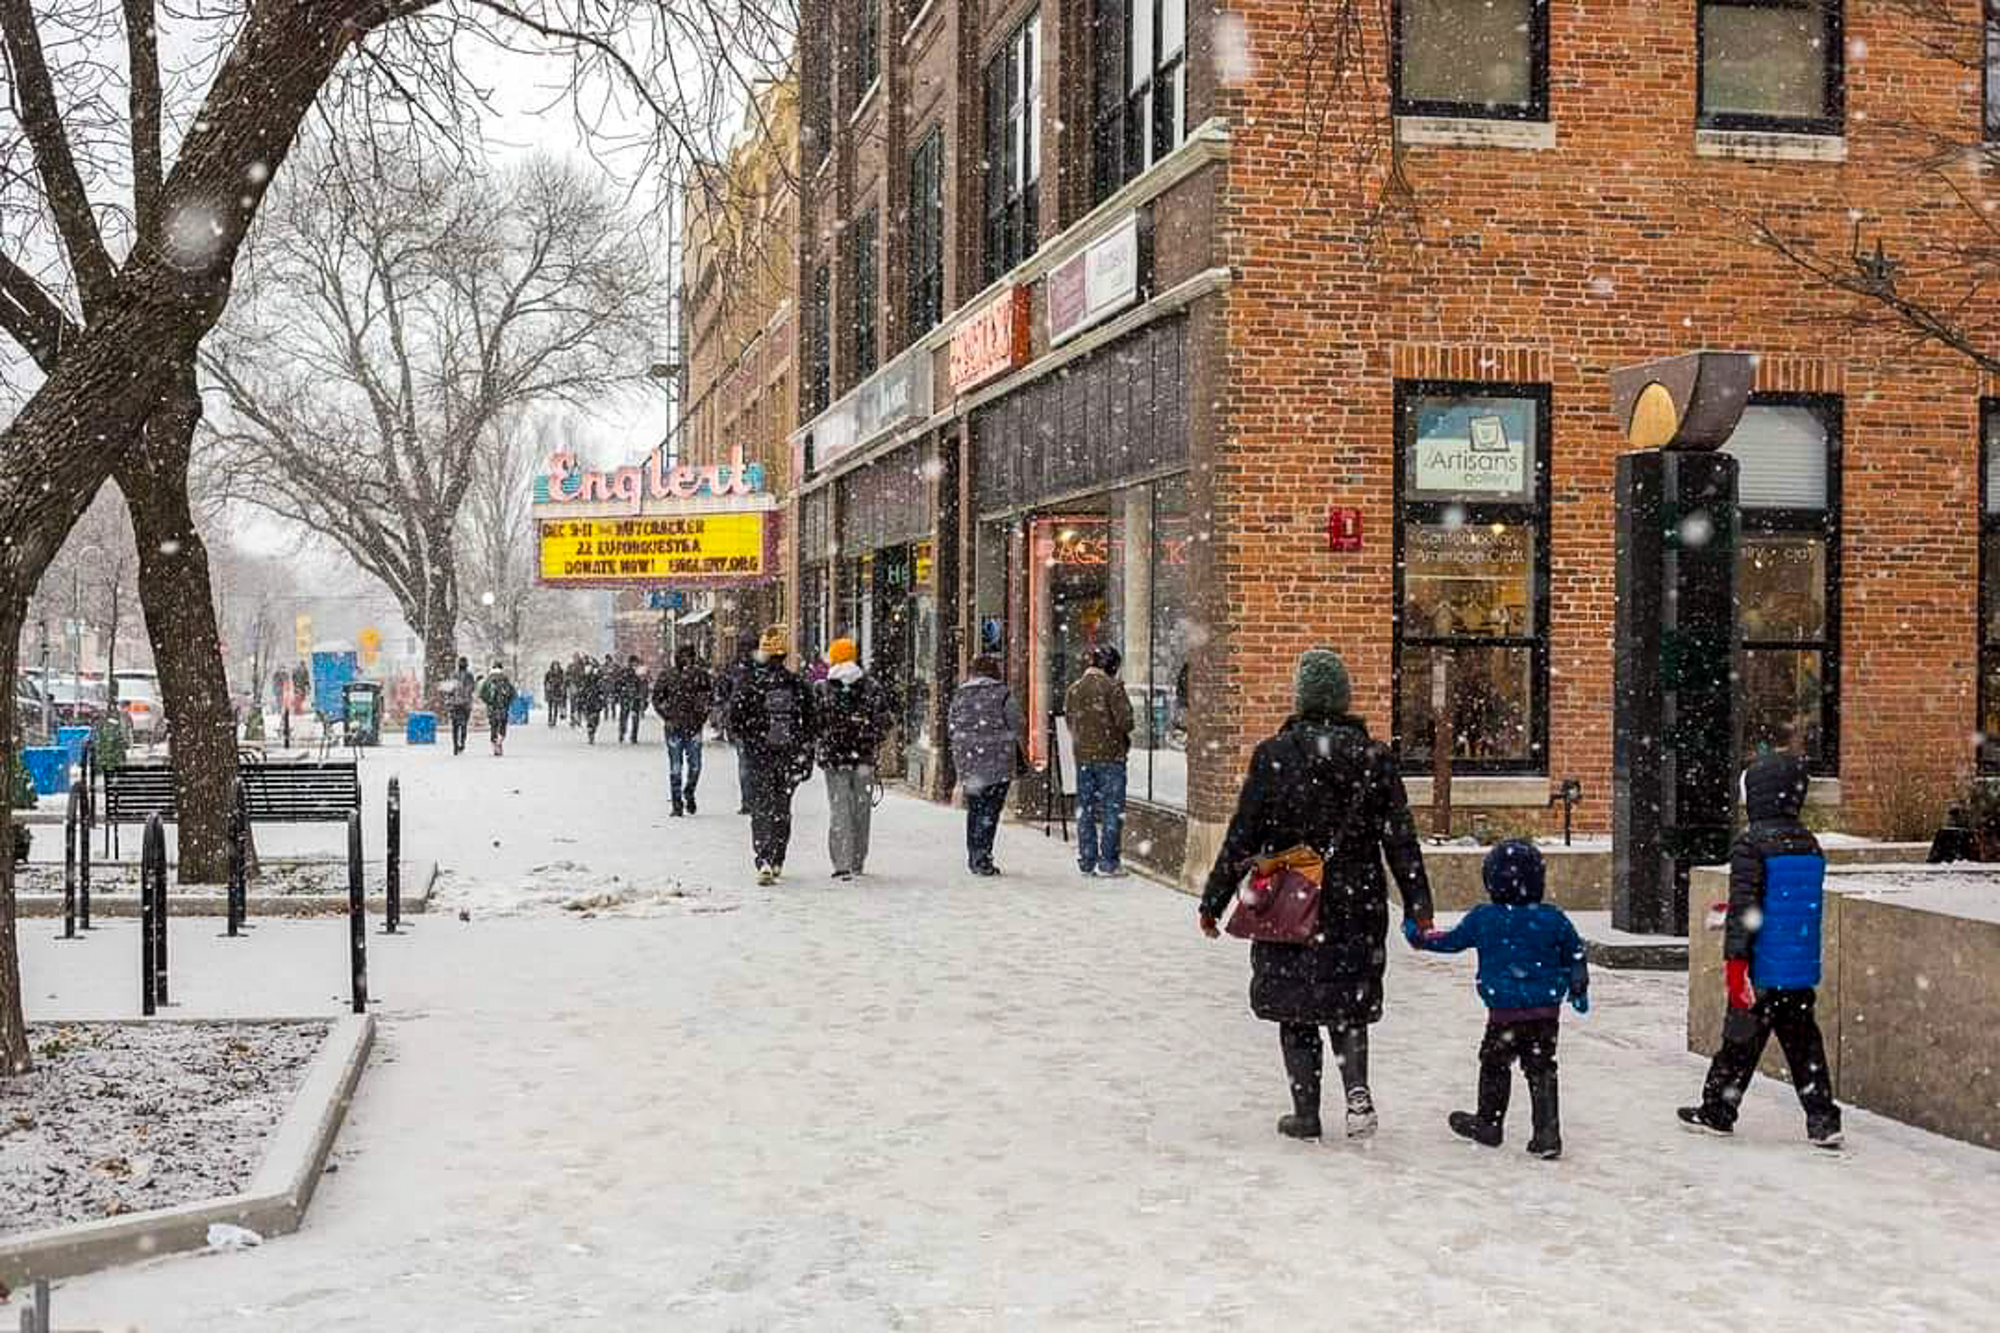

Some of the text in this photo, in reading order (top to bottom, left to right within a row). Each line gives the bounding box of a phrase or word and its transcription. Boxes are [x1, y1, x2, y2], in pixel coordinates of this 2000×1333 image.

[1431, 449, 1518, 471] Artisans
[549, 444, 753, 515] Englert
[563, 560, 616, 575] DONATE
